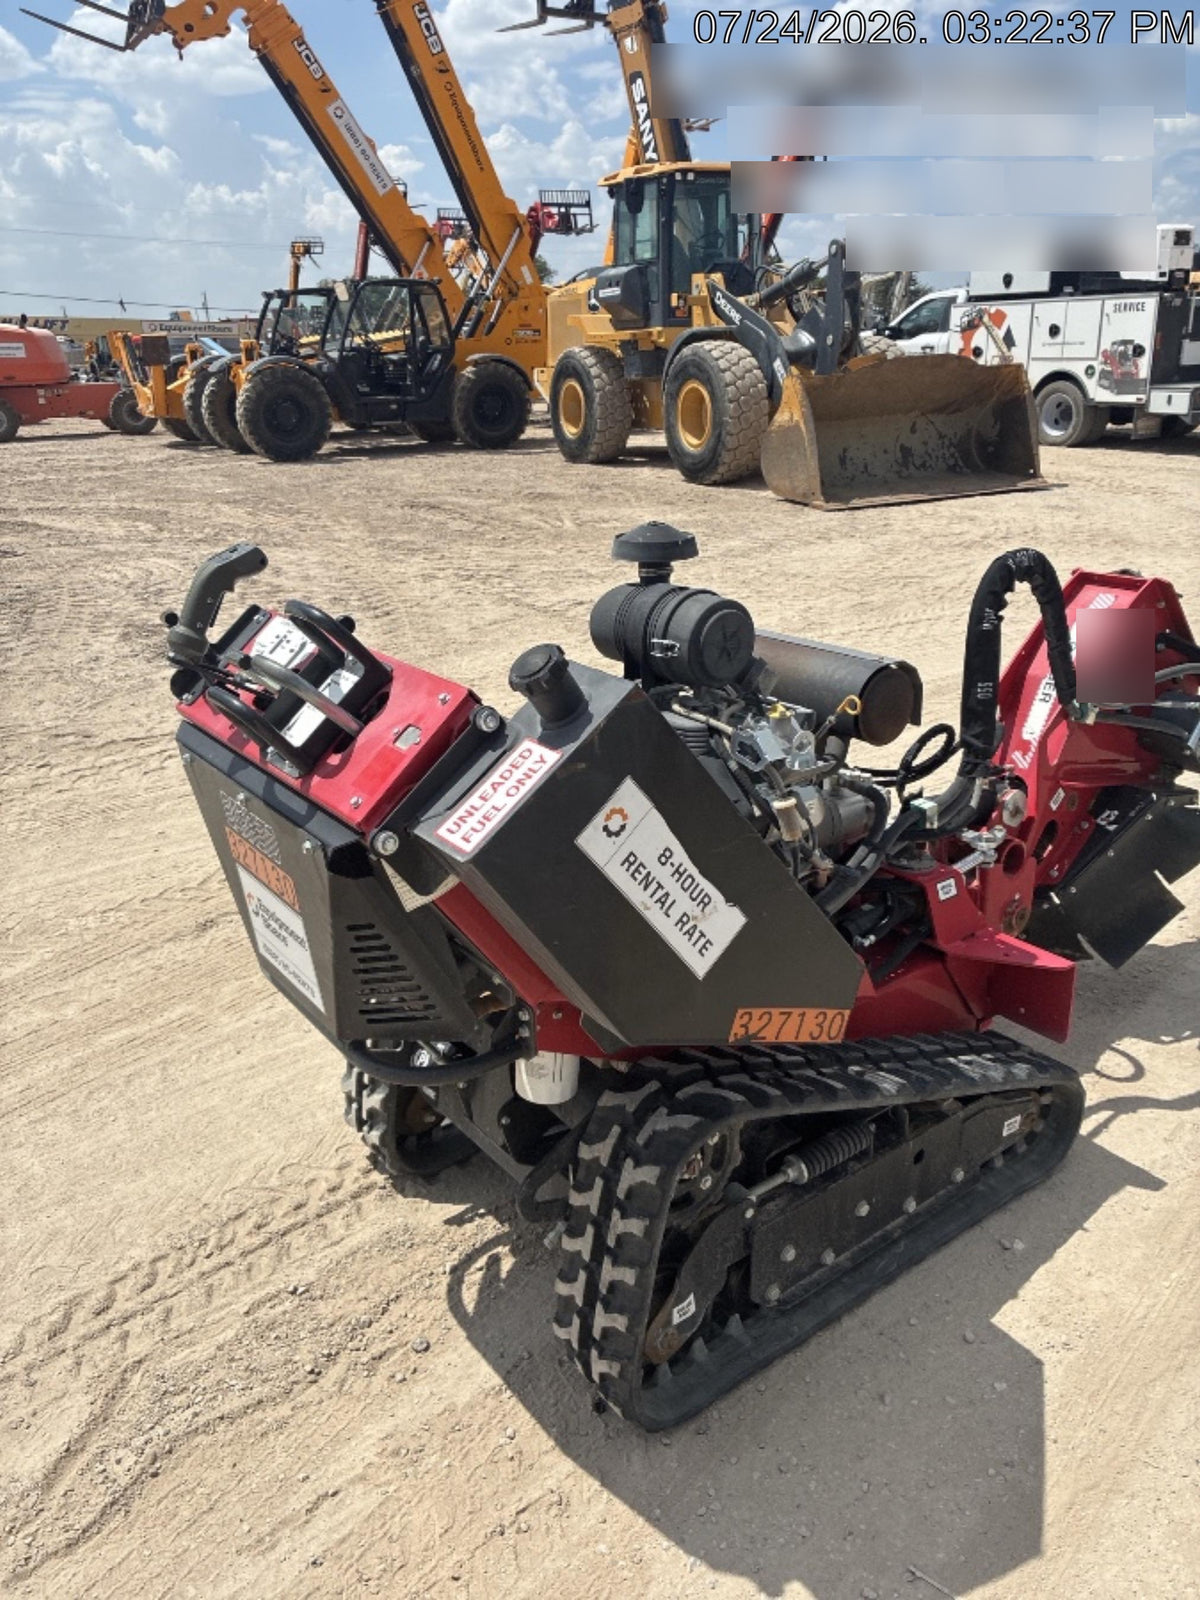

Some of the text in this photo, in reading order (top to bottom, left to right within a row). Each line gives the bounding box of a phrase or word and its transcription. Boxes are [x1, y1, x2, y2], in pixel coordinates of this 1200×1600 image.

[413, 3, 443, 54] JCB
[292, 38, 324, 80] JCB
[632, 77, 658, 160] SANY
[714, 291, 742, 326] DEERE
[1113, 302, 1146, 313] SERVICE
[446, 748, 533, 835] UNLEADED
[461, 754, 547, 844] FUEL ONLY
[620, 851, 714, 958] RENTAL RATE
[657, 846, 713, 913] 8-HOUR
[733, 1010, 845, 1041] 327130
